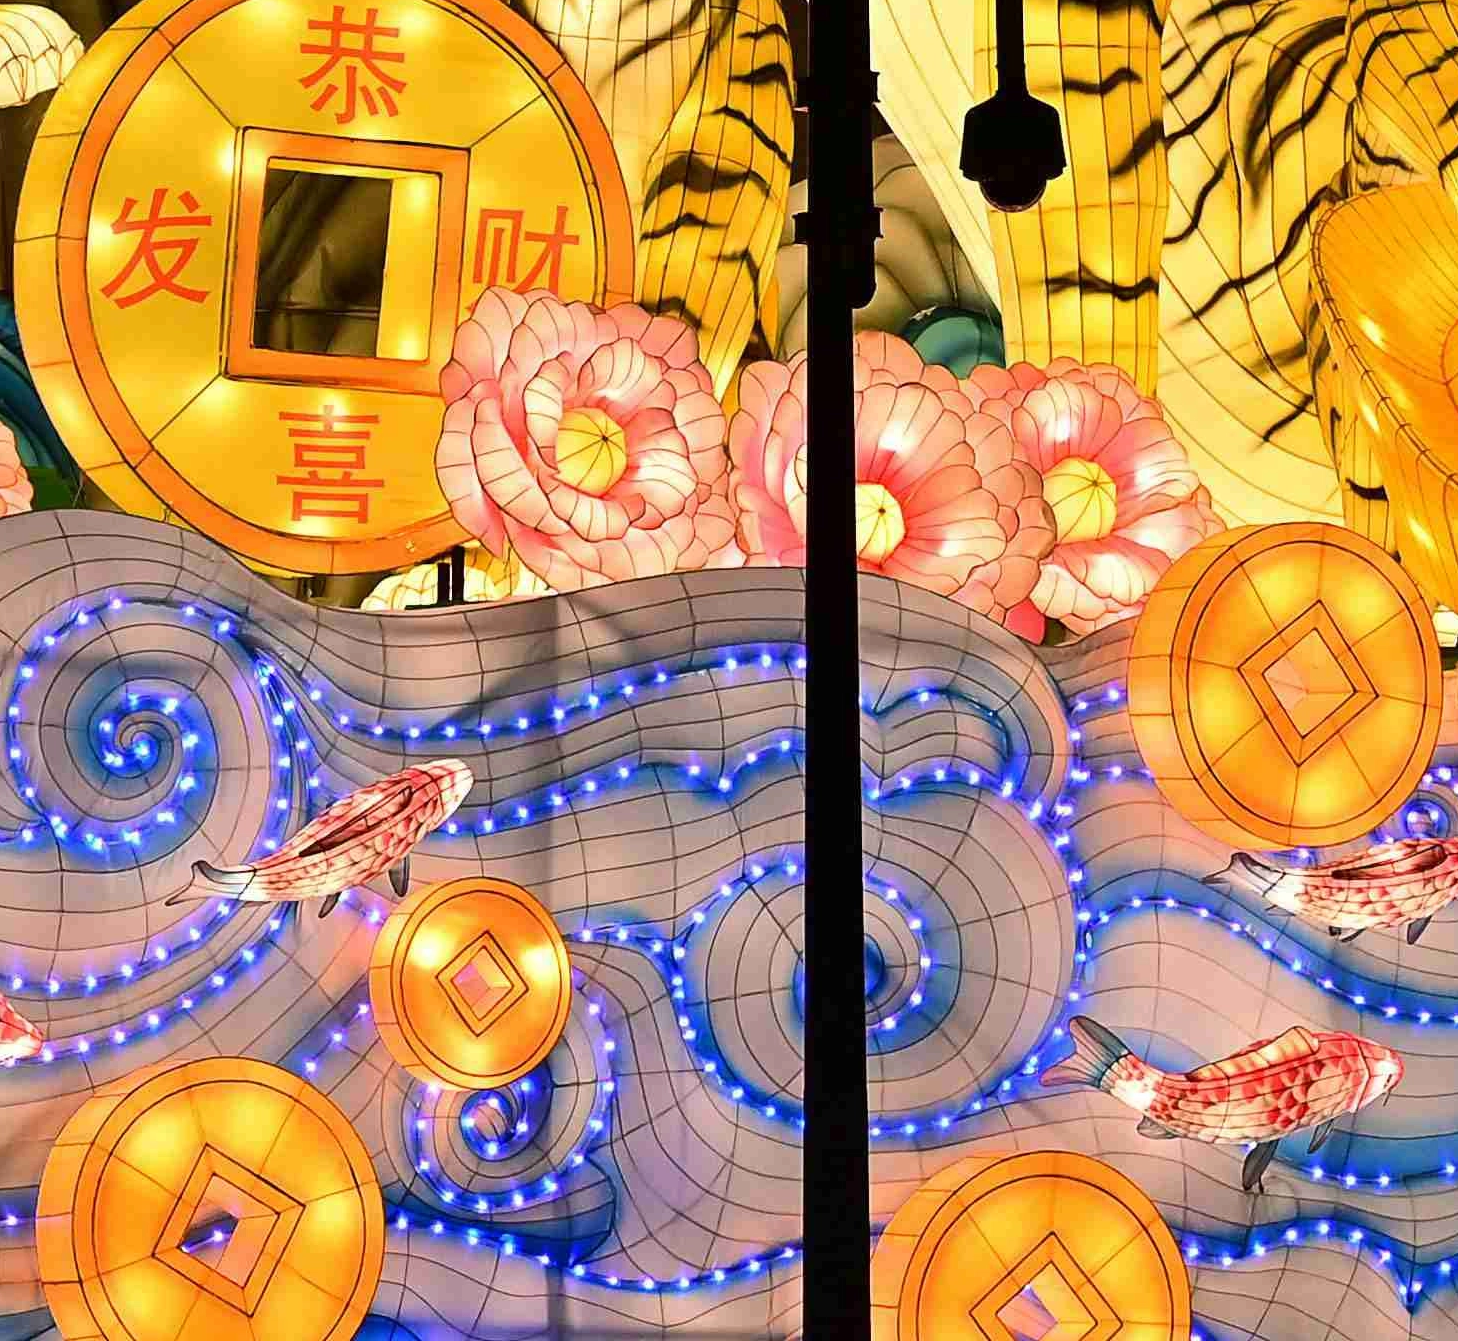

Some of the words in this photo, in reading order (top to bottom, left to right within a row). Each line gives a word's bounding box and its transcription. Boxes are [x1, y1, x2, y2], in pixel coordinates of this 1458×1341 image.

[298, 5, 408, 125] 恭
[100, 187, 213, 310] 发
[276, 404, 385, 525] 喜
